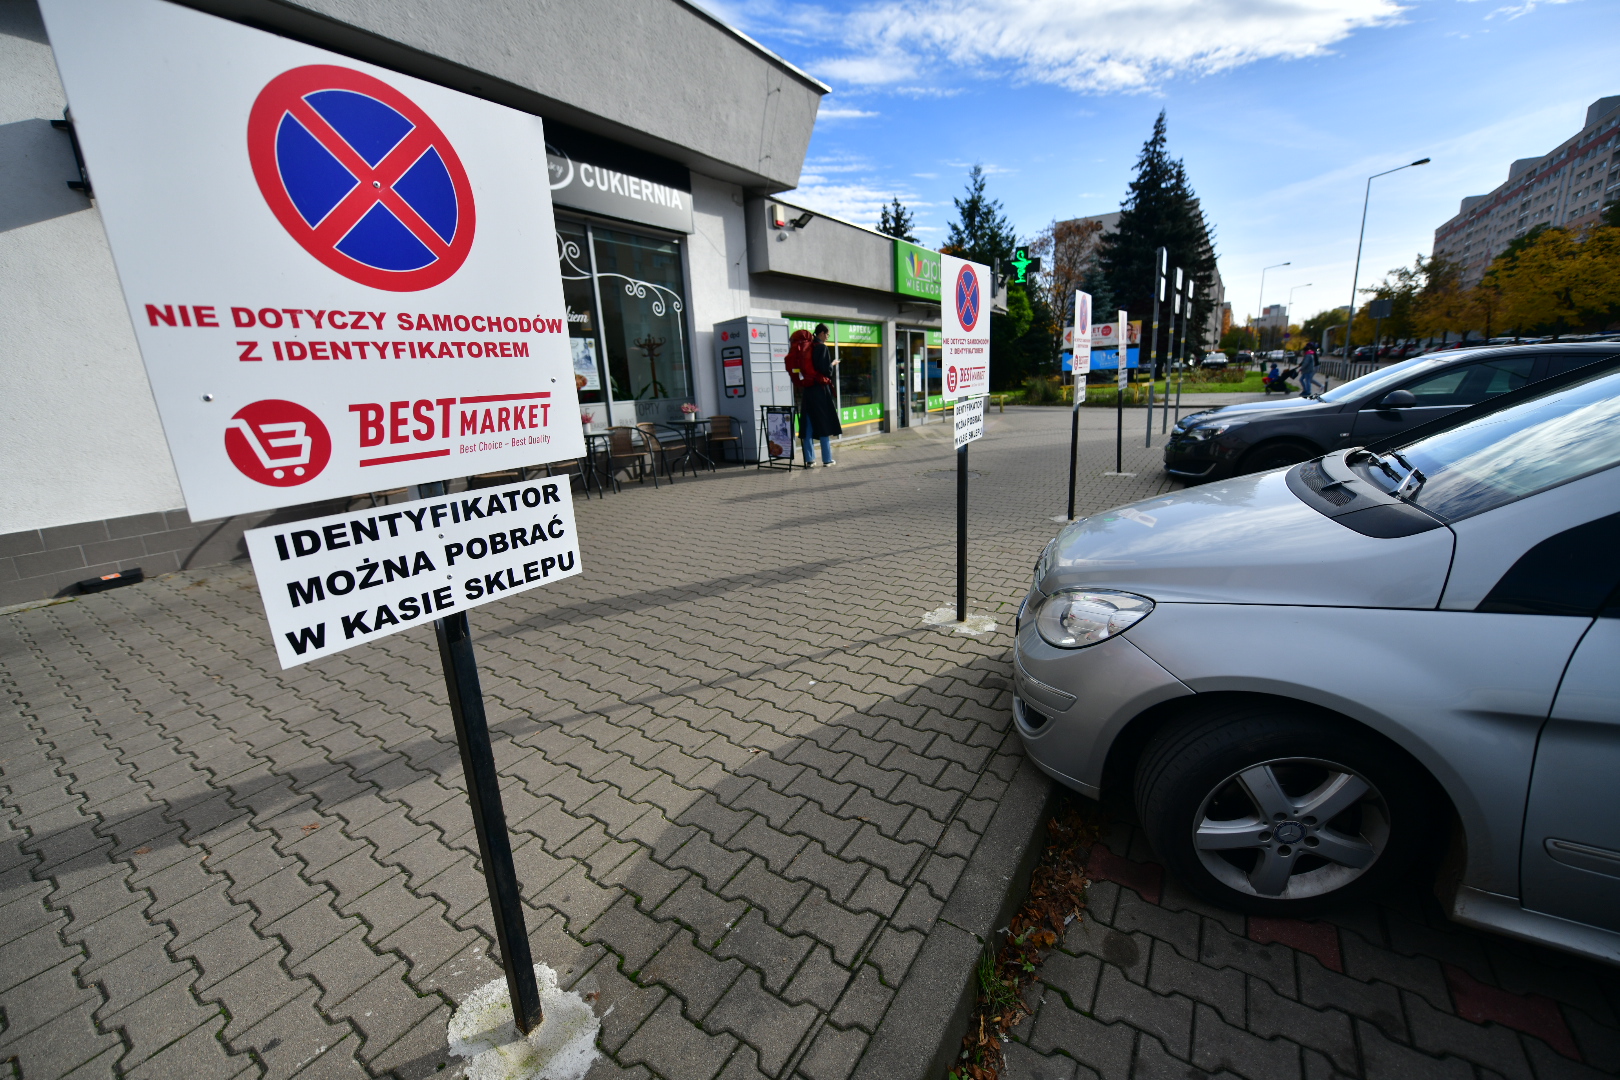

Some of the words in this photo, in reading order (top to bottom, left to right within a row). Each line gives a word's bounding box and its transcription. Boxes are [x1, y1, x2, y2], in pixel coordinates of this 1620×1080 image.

[580, 163, 683, 210] CUKIERNIA
[906, 278, 941, 295] WIELKOP
[145, 304, 220, 327] NIE
[231, 307, 387, 331] DOTYCZY
[398, 312, 563, 334] SAMOCHODÓW
[793, 320, 818, 331] APTEK
[730, 331, 740, 339] dpd
[758, 330, 766, 338] dpd
[849, 325, 871, 334] APTEKA
[236, 341, 263, 362] Z
[273, 341, 530, 362] IDENTYFIKATOREM
[633, 402, 660, 417] TORTY
[348, 397, 457, 448] BEST
[460, 403, 551, 436] MARKET
[459, 442, 477, 454] Best
[478, 440, 503, 452] Choice
[511, 435, 527, 447] Best
[528, 434, 551, 446] Quality
[274, 483, 560, 561] IDENTYFIKATOR
[287, 551, 436, 608] MOŻNA
[445, 514, 565, 566] POBRAĆ
[285, 623, 326, 656] W
[341, 585, 455, 640] KASIE
[465, 551, 575, 600] SKLEPU
